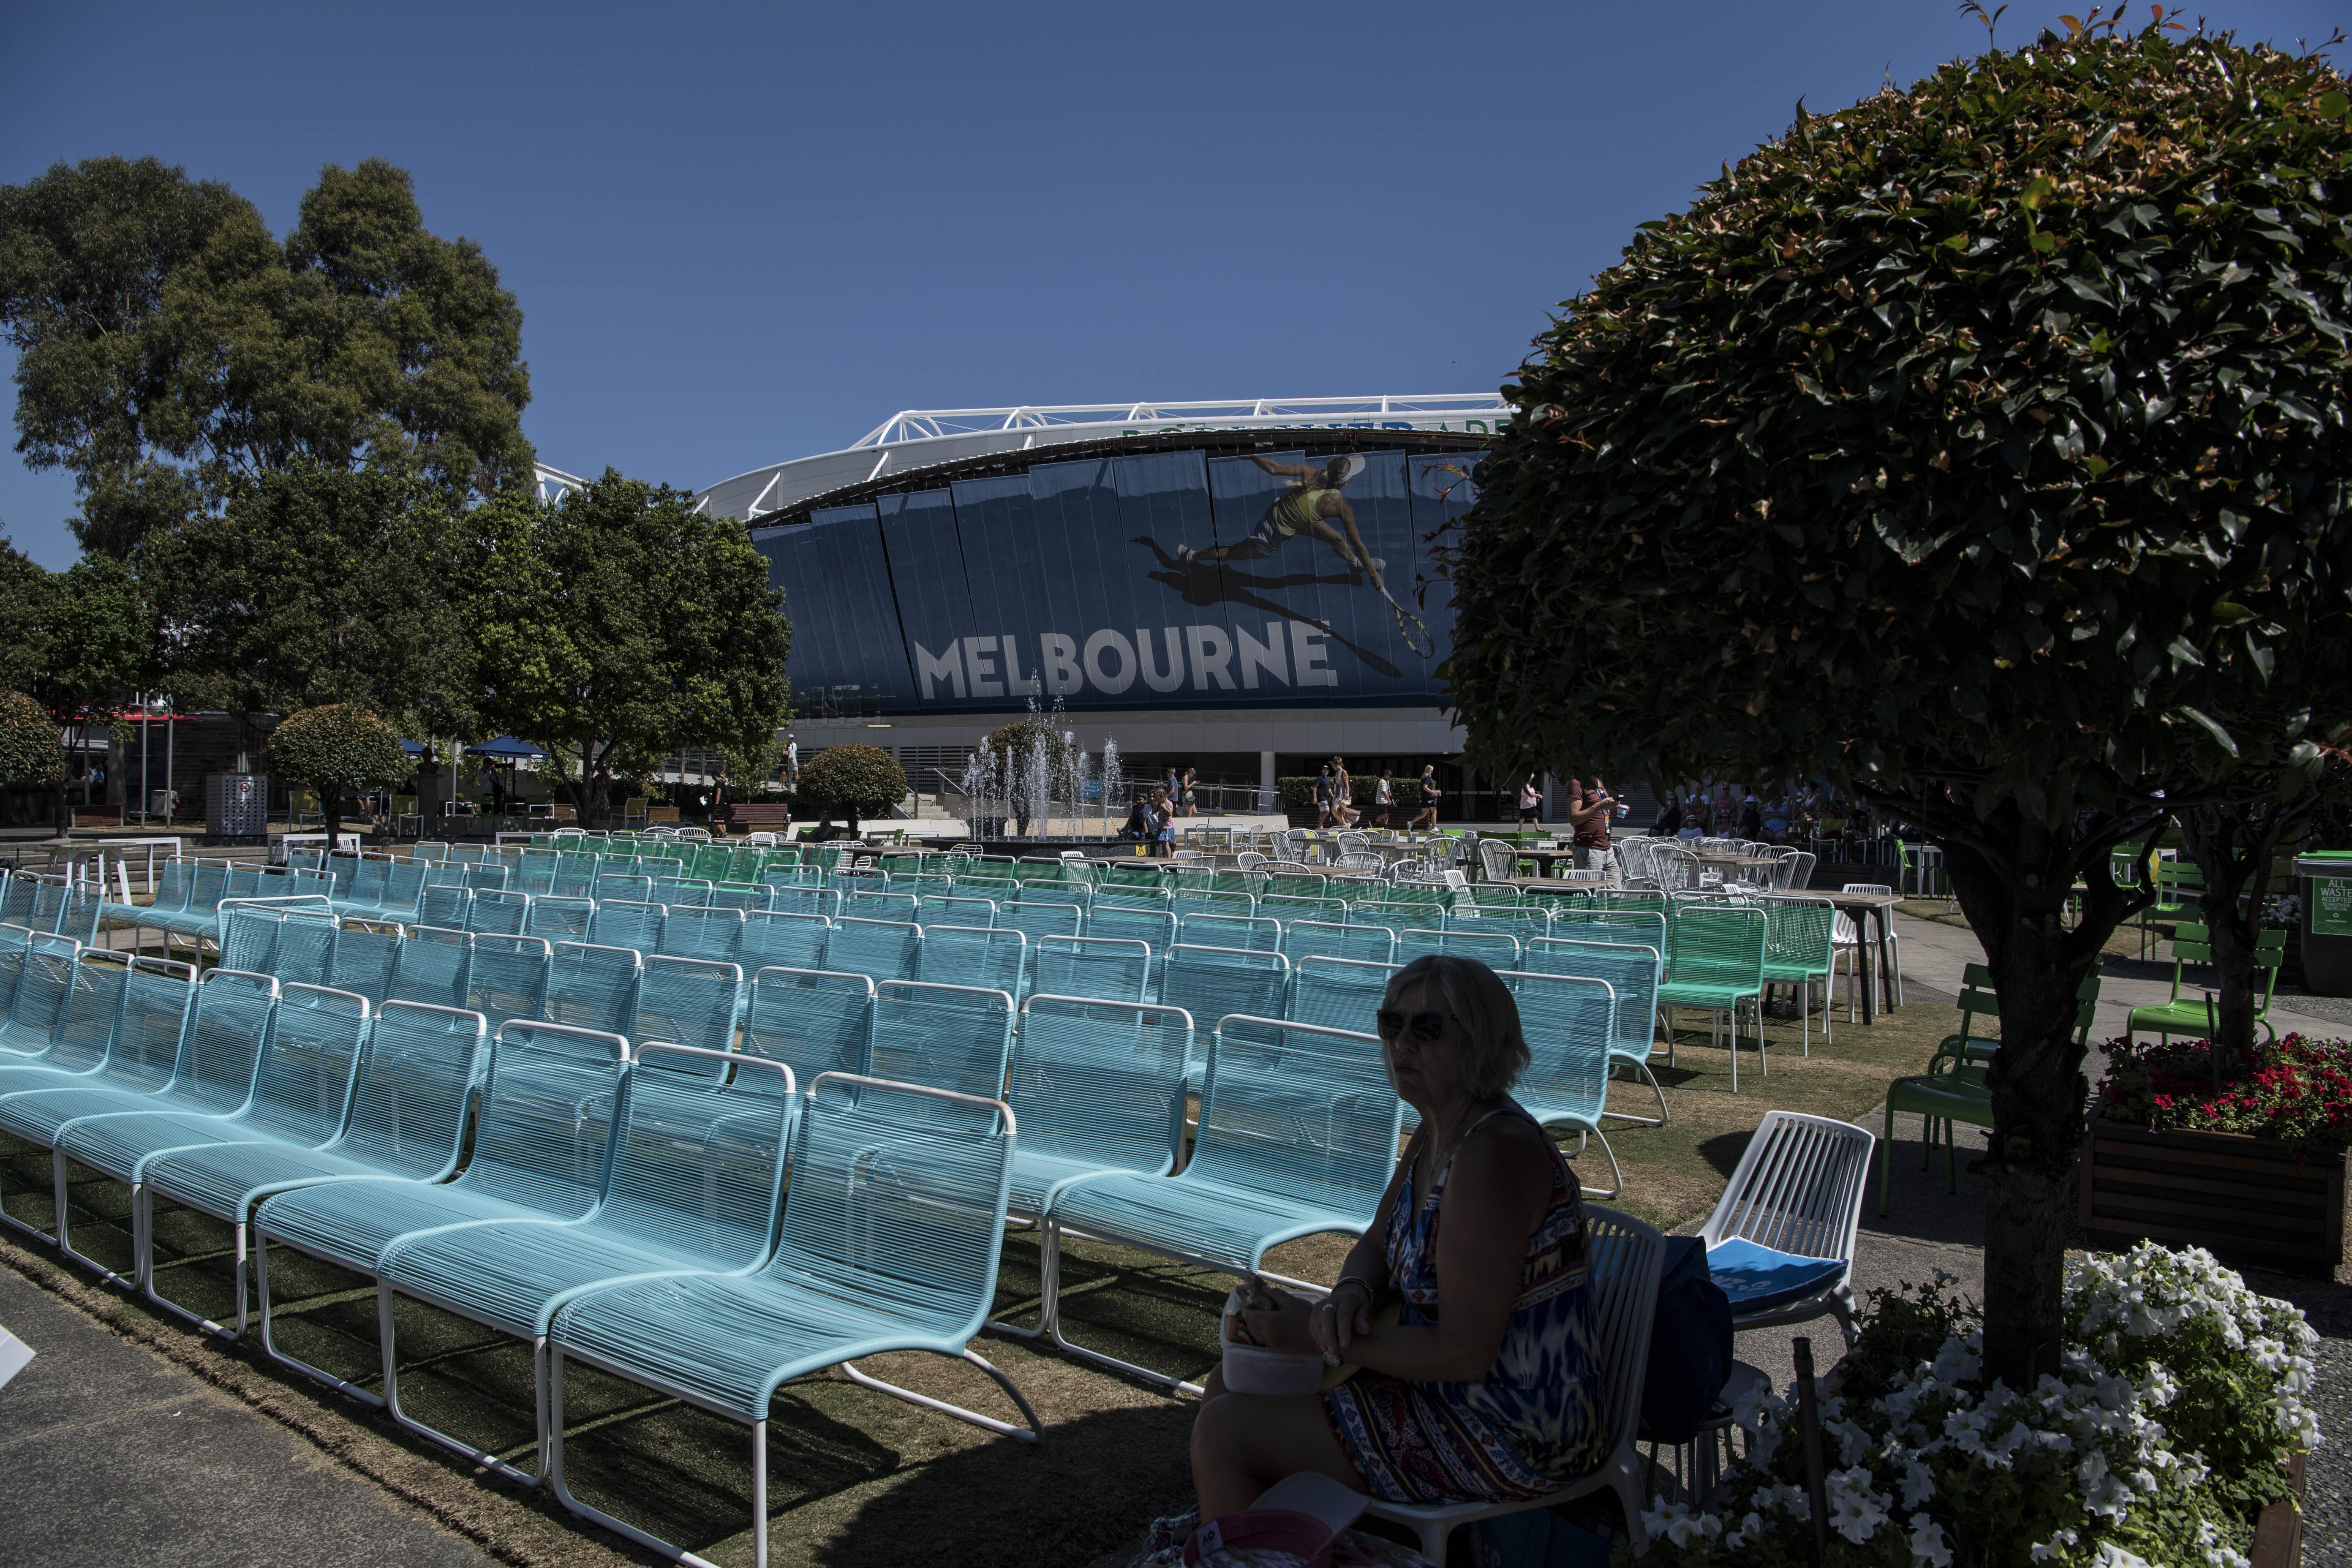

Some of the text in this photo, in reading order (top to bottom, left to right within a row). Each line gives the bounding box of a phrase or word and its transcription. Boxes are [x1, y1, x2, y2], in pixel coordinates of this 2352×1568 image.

[915, 620, 1338, 700] MELBOURNE
[2328, 879, 2346, 888] ALL
[2320, 887, 2352, 897] WASTE
